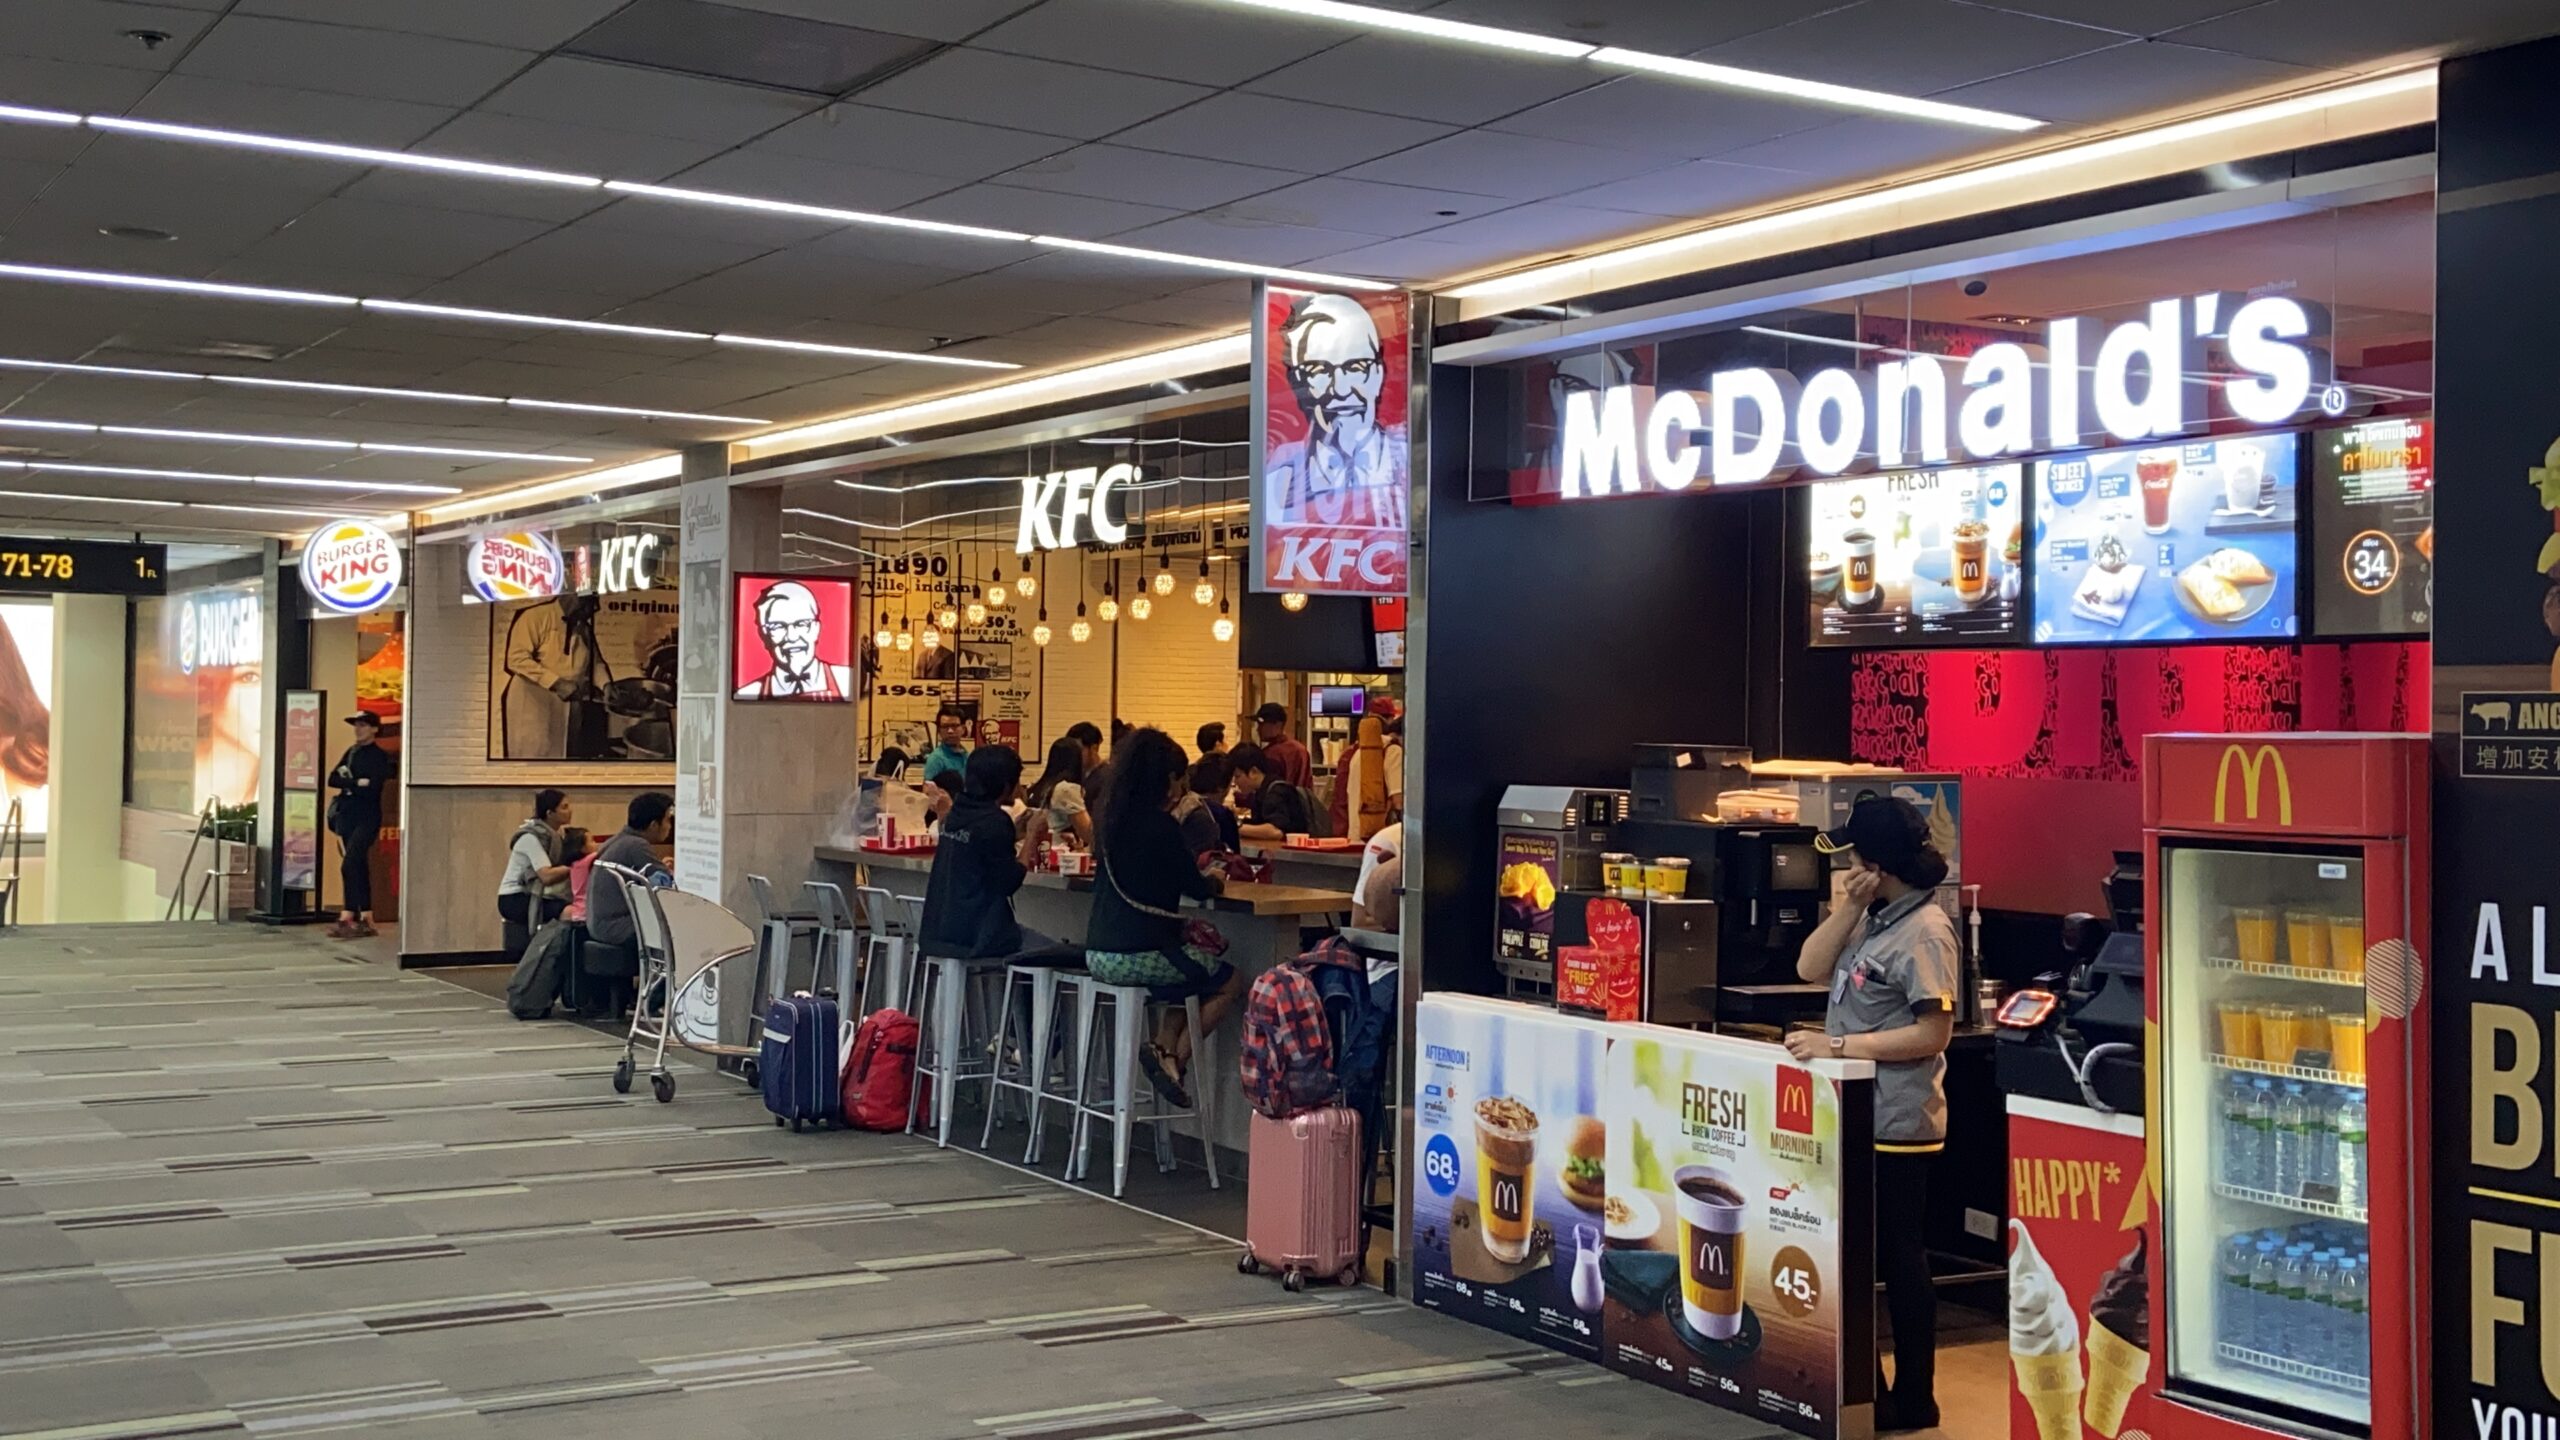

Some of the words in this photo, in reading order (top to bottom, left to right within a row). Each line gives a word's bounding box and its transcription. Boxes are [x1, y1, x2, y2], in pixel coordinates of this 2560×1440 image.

[1560, 294, 2310, 498] McDonald's
[1887, 472, 1940, 492] FRESH
[1015, 463, 1134, 554] KFC
[1, 553, 74, 579] 71-78
[135, 557, 146, 579] 1
[316, 536, 386, 567] BURGER
[598, 533, 654, 595] KFC
[877, 554, 948, 577] 1890
[1274, 536, 1397, 584] KFC
[2353, 549, 2388, 580] 34
[320, 553, 390, 589] KING
[877, 684, 941, 696] 1965
[992, 688, 1031, 700] today
[2470, 902, 2508, 981] A
[1425, 1044, 1466, 1065] AFTERNOON
[1682, 1082, 1746, 1131] FRESH
[1711, 1128, 1735, 1145] COFFEE
[1770, 1131, 1814, 1157] MORNING
